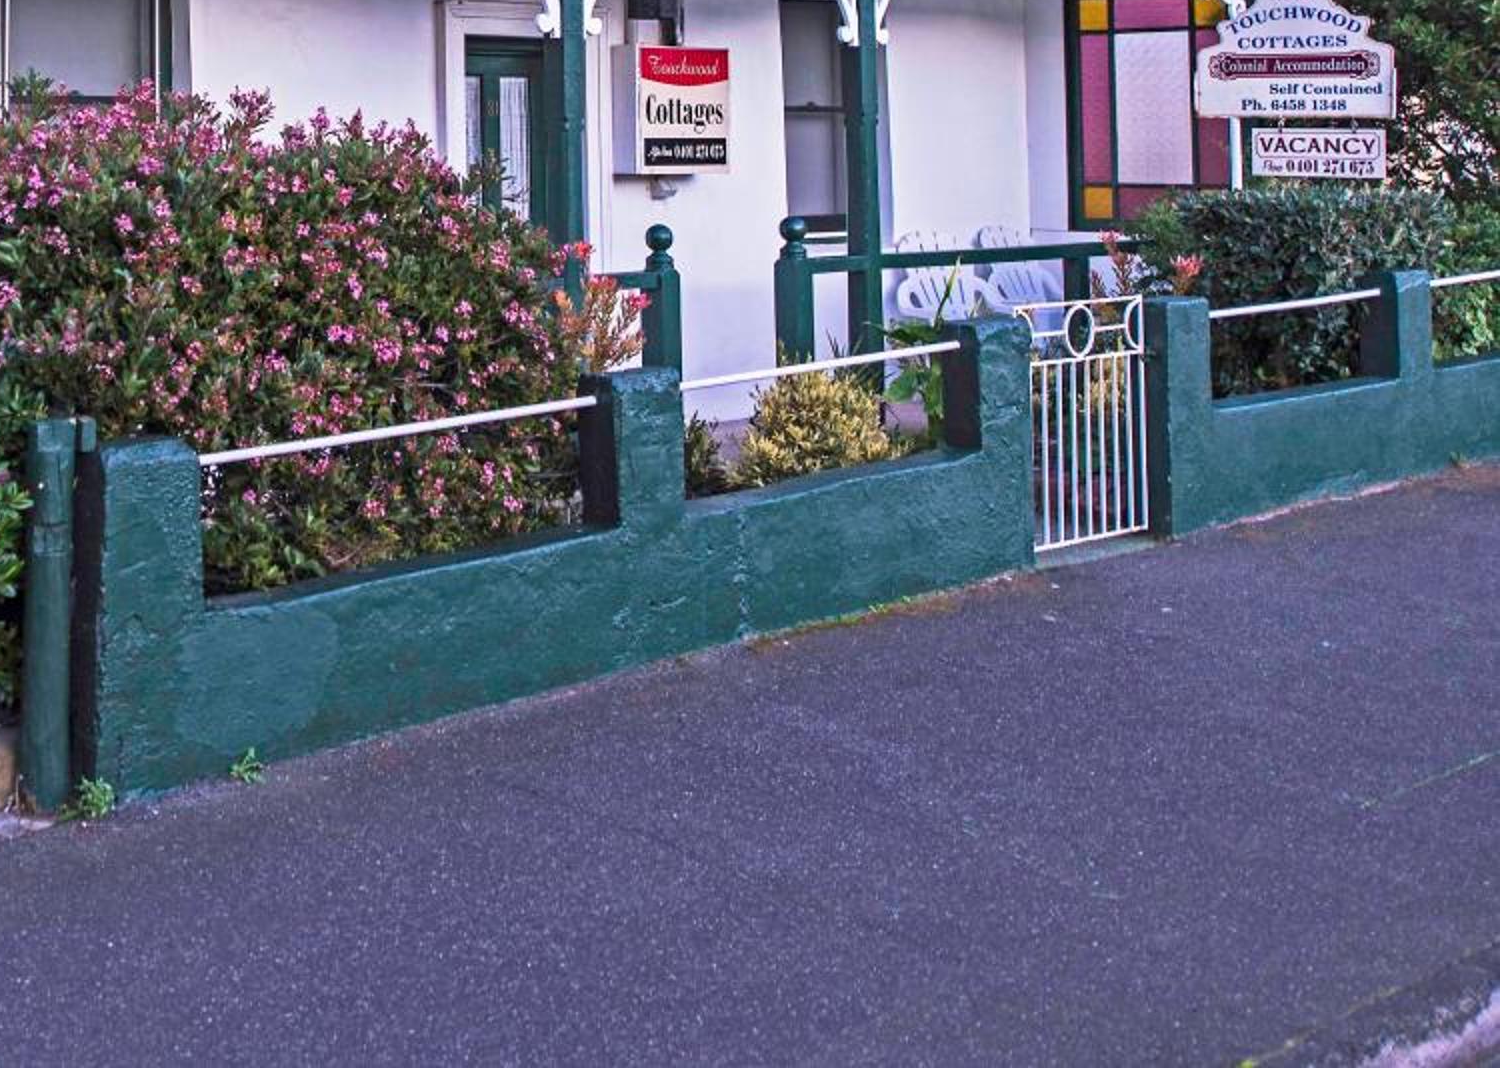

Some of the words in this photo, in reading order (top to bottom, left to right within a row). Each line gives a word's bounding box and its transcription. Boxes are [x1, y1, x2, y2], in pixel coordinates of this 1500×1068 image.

[1226, 7, 1361, 35] TOUCHWOOD
[1237, 35, 1348, 49] COTTAGES
[1220, 58, 1267, 73] Colonial
[1269, 83, 1299, 95] Self
[1302, 83, 1384, 95] Contained
[1240, 98, 1267, 111] Ph.
[1270, 99, 1306, 111] 6458
[1312, 98, 1347, 111] 1348
[645, 94, 724, 135] Cottages
[1260, 137, 1376, 154] VACANCY
